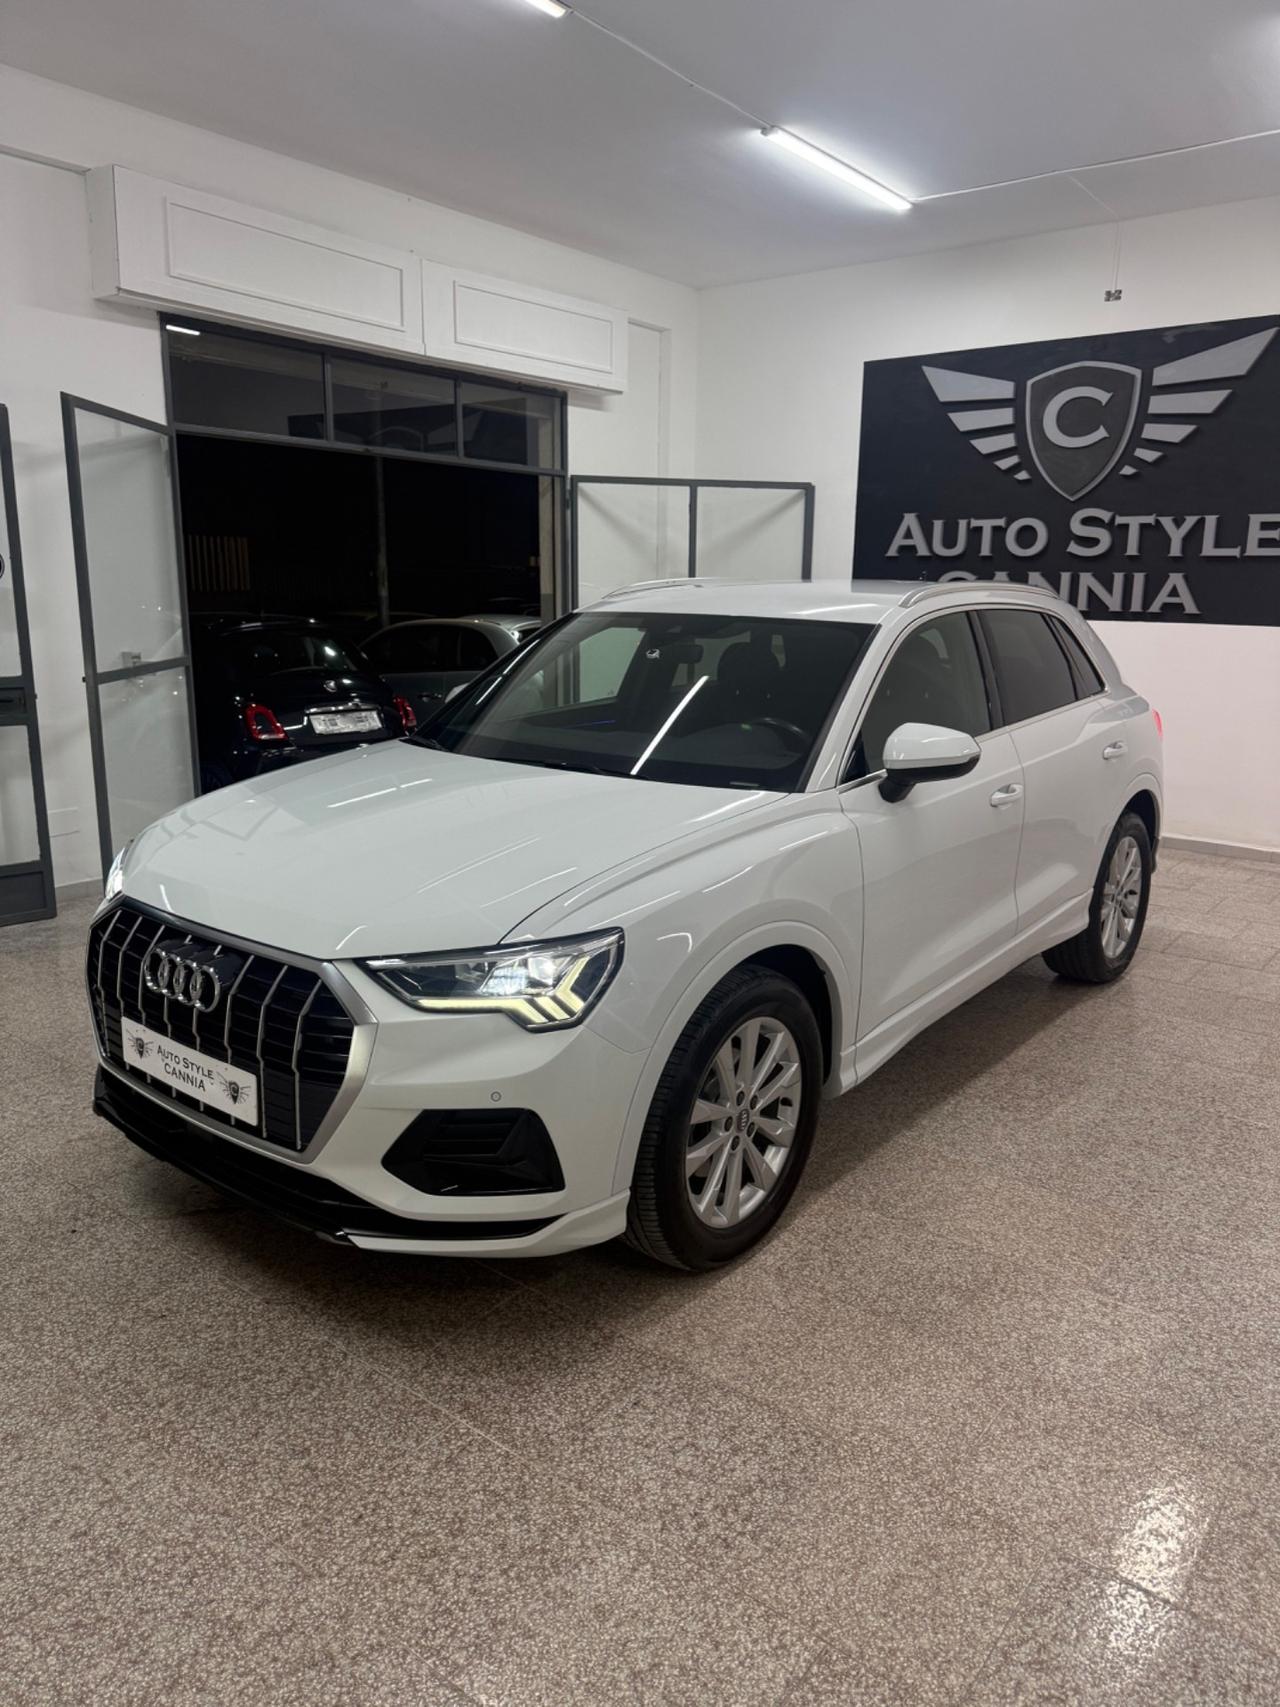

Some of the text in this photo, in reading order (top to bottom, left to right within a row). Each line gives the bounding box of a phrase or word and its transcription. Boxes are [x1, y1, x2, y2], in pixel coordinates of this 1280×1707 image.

[1043, 386, 1114, 448] C
[885, 507, 1280, 559] AUTO STYLE
[936, 571, 1201, 615] NNIA
[157, 1045, 181, 1065] AUTO
[182, 1057, 215, 1080] STYLE
[164, 1063, 206, 1092] CANNIA
